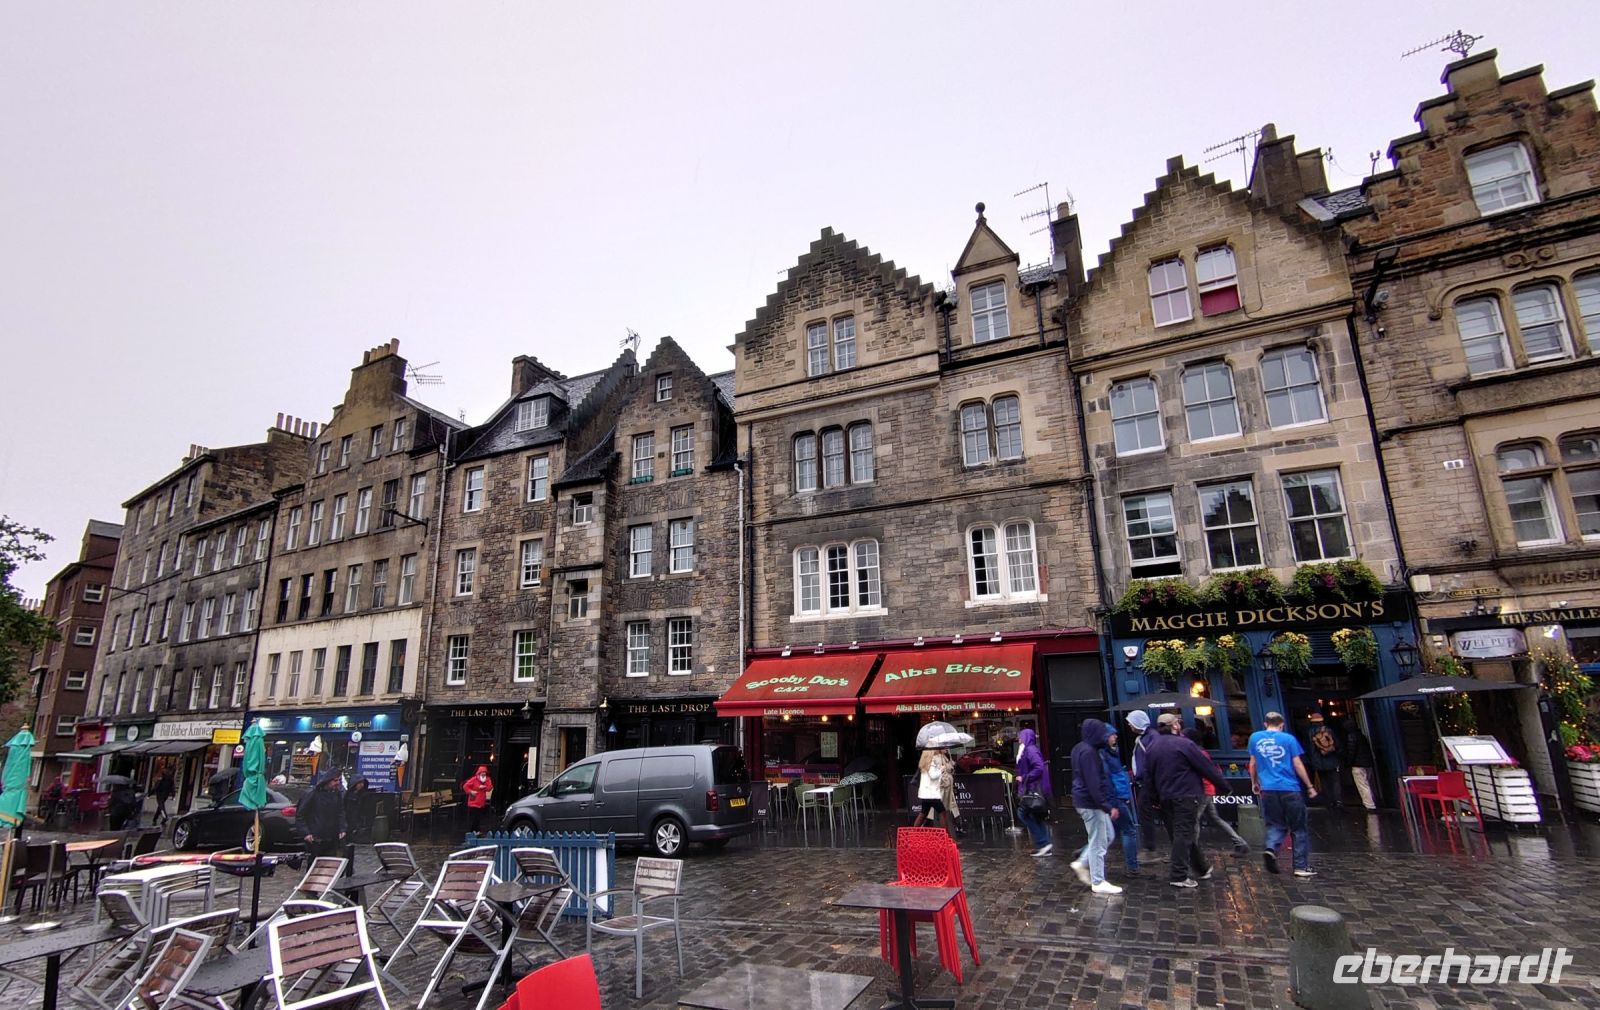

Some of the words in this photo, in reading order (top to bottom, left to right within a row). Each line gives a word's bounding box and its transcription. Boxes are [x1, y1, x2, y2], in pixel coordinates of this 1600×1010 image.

[1130, 611, 1229, 632] MAGGIE
[1235, 600, 1385, 626] DICKSON'S
[1499, 613, 1532, 625] THE
[884, 667, 937, 683] Alba
[945, 663, 1022, 678] Bistro
[745, 675, 806, 690] Scooby
[808, 675, 849, 686] Doo's
[450, 709, 466, 717] THE
[468, 709, 489, 717] LAST
[491, 708, 515, 716] DROP
[628, 705, 648, 713] THE
[651, 704, 677, 713] LAST
[680, 703, 710, 712] DROP
[913, 703, 939, 711] Bistro,
[941, 703, 962, 711] Open
[160, 725, 171, 737] Bill
[171, 724, 188, 737] Baber
[188, 723, 214, 737] Knitwea
[1212, 795, 1253, 804] KSON'S
